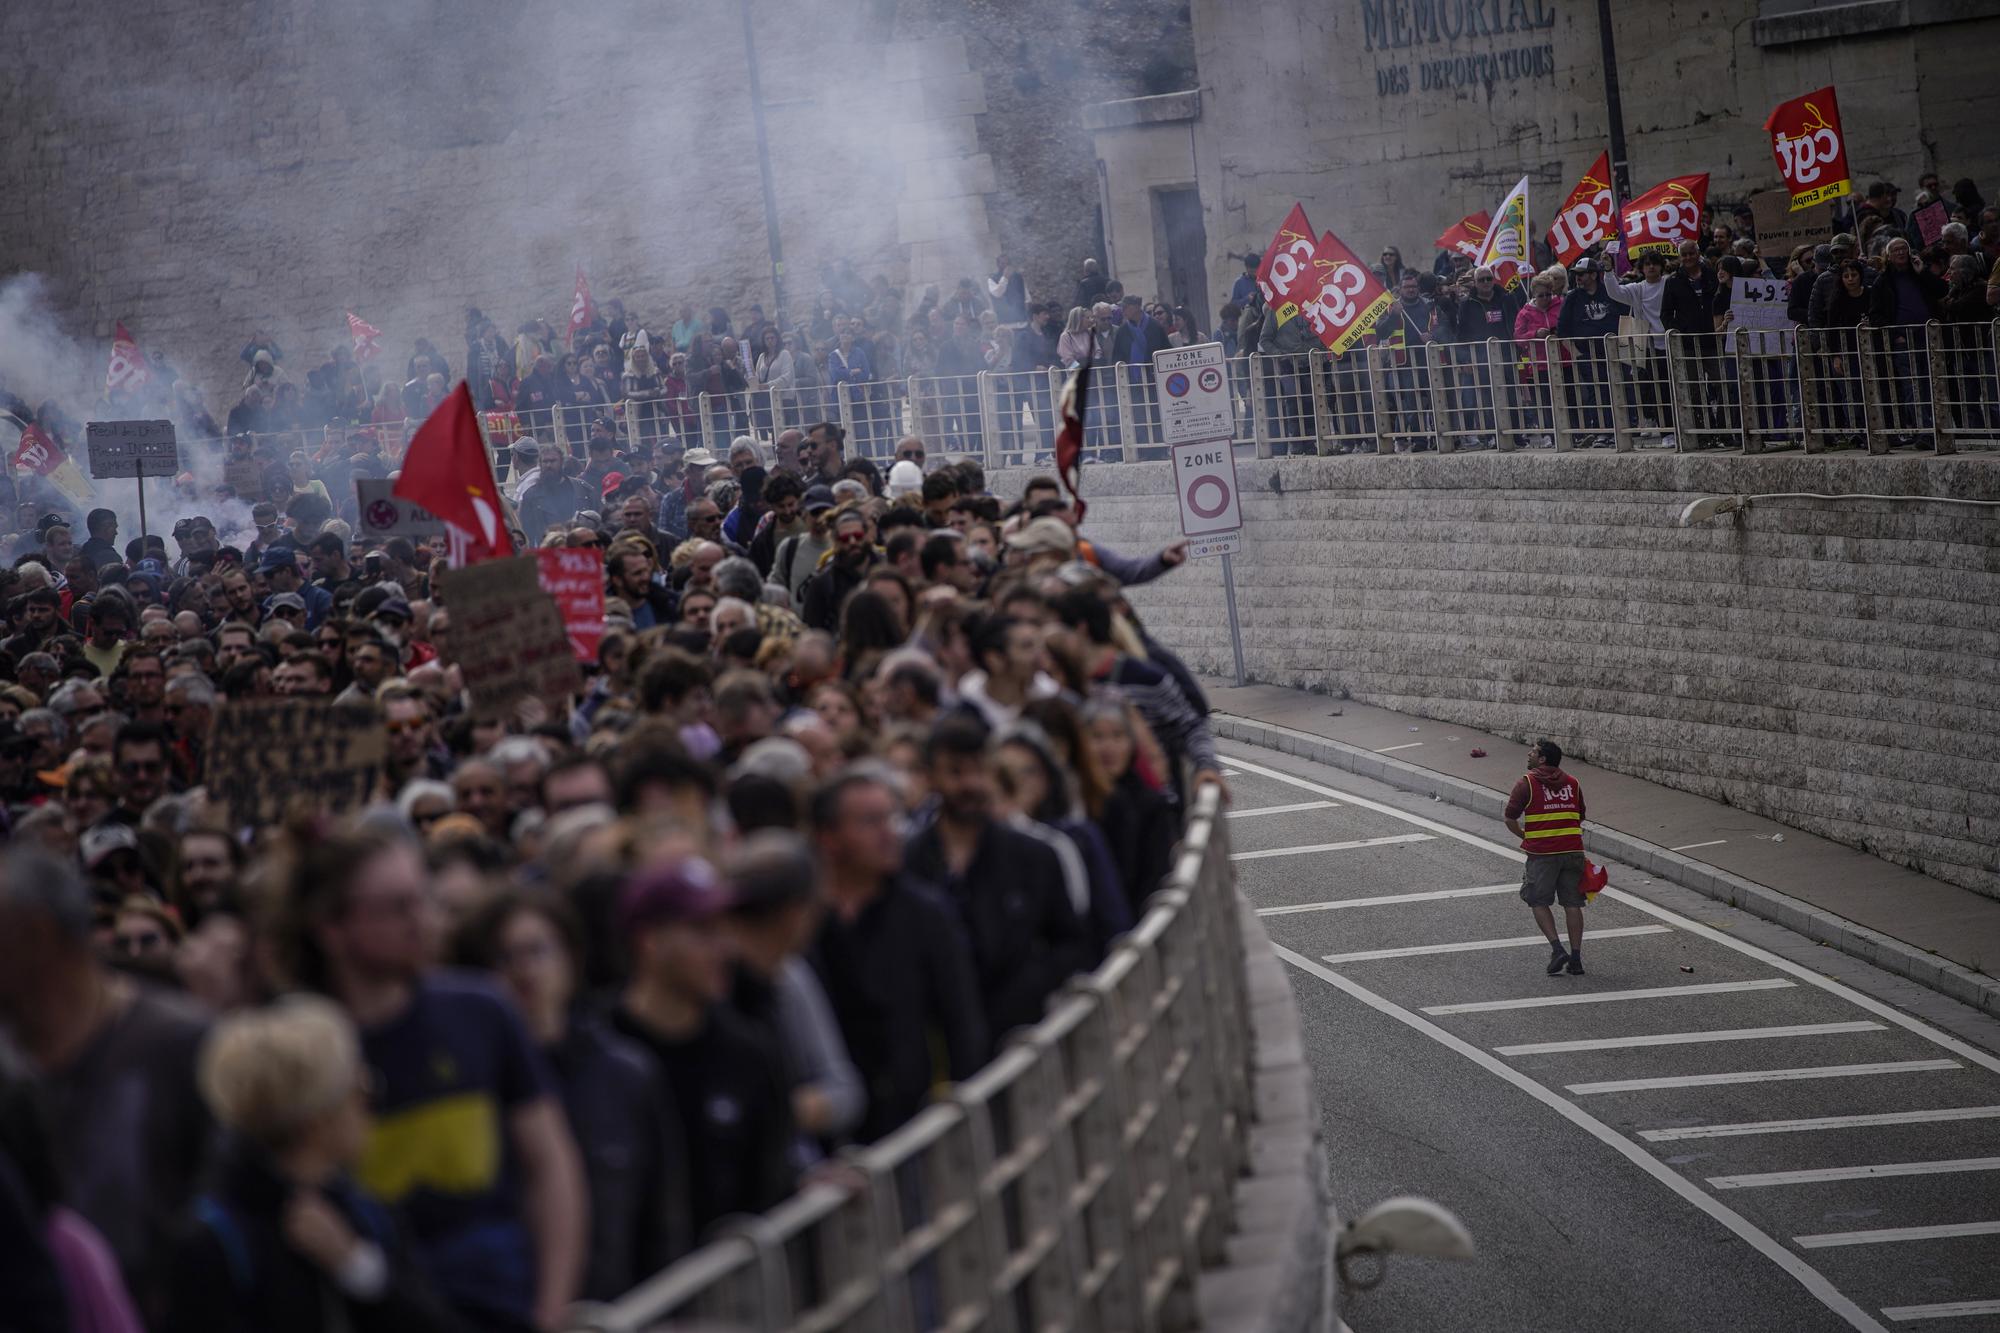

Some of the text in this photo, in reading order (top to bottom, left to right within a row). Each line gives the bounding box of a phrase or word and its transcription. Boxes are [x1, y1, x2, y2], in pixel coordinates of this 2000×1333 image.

[1376, 65, 1410, 97] DES
[1176, 350, 1203, 361] ZONE
[1165, 361, 1187, 370] TRAFIC
[1184, 452, 1223, 467] ZONE
